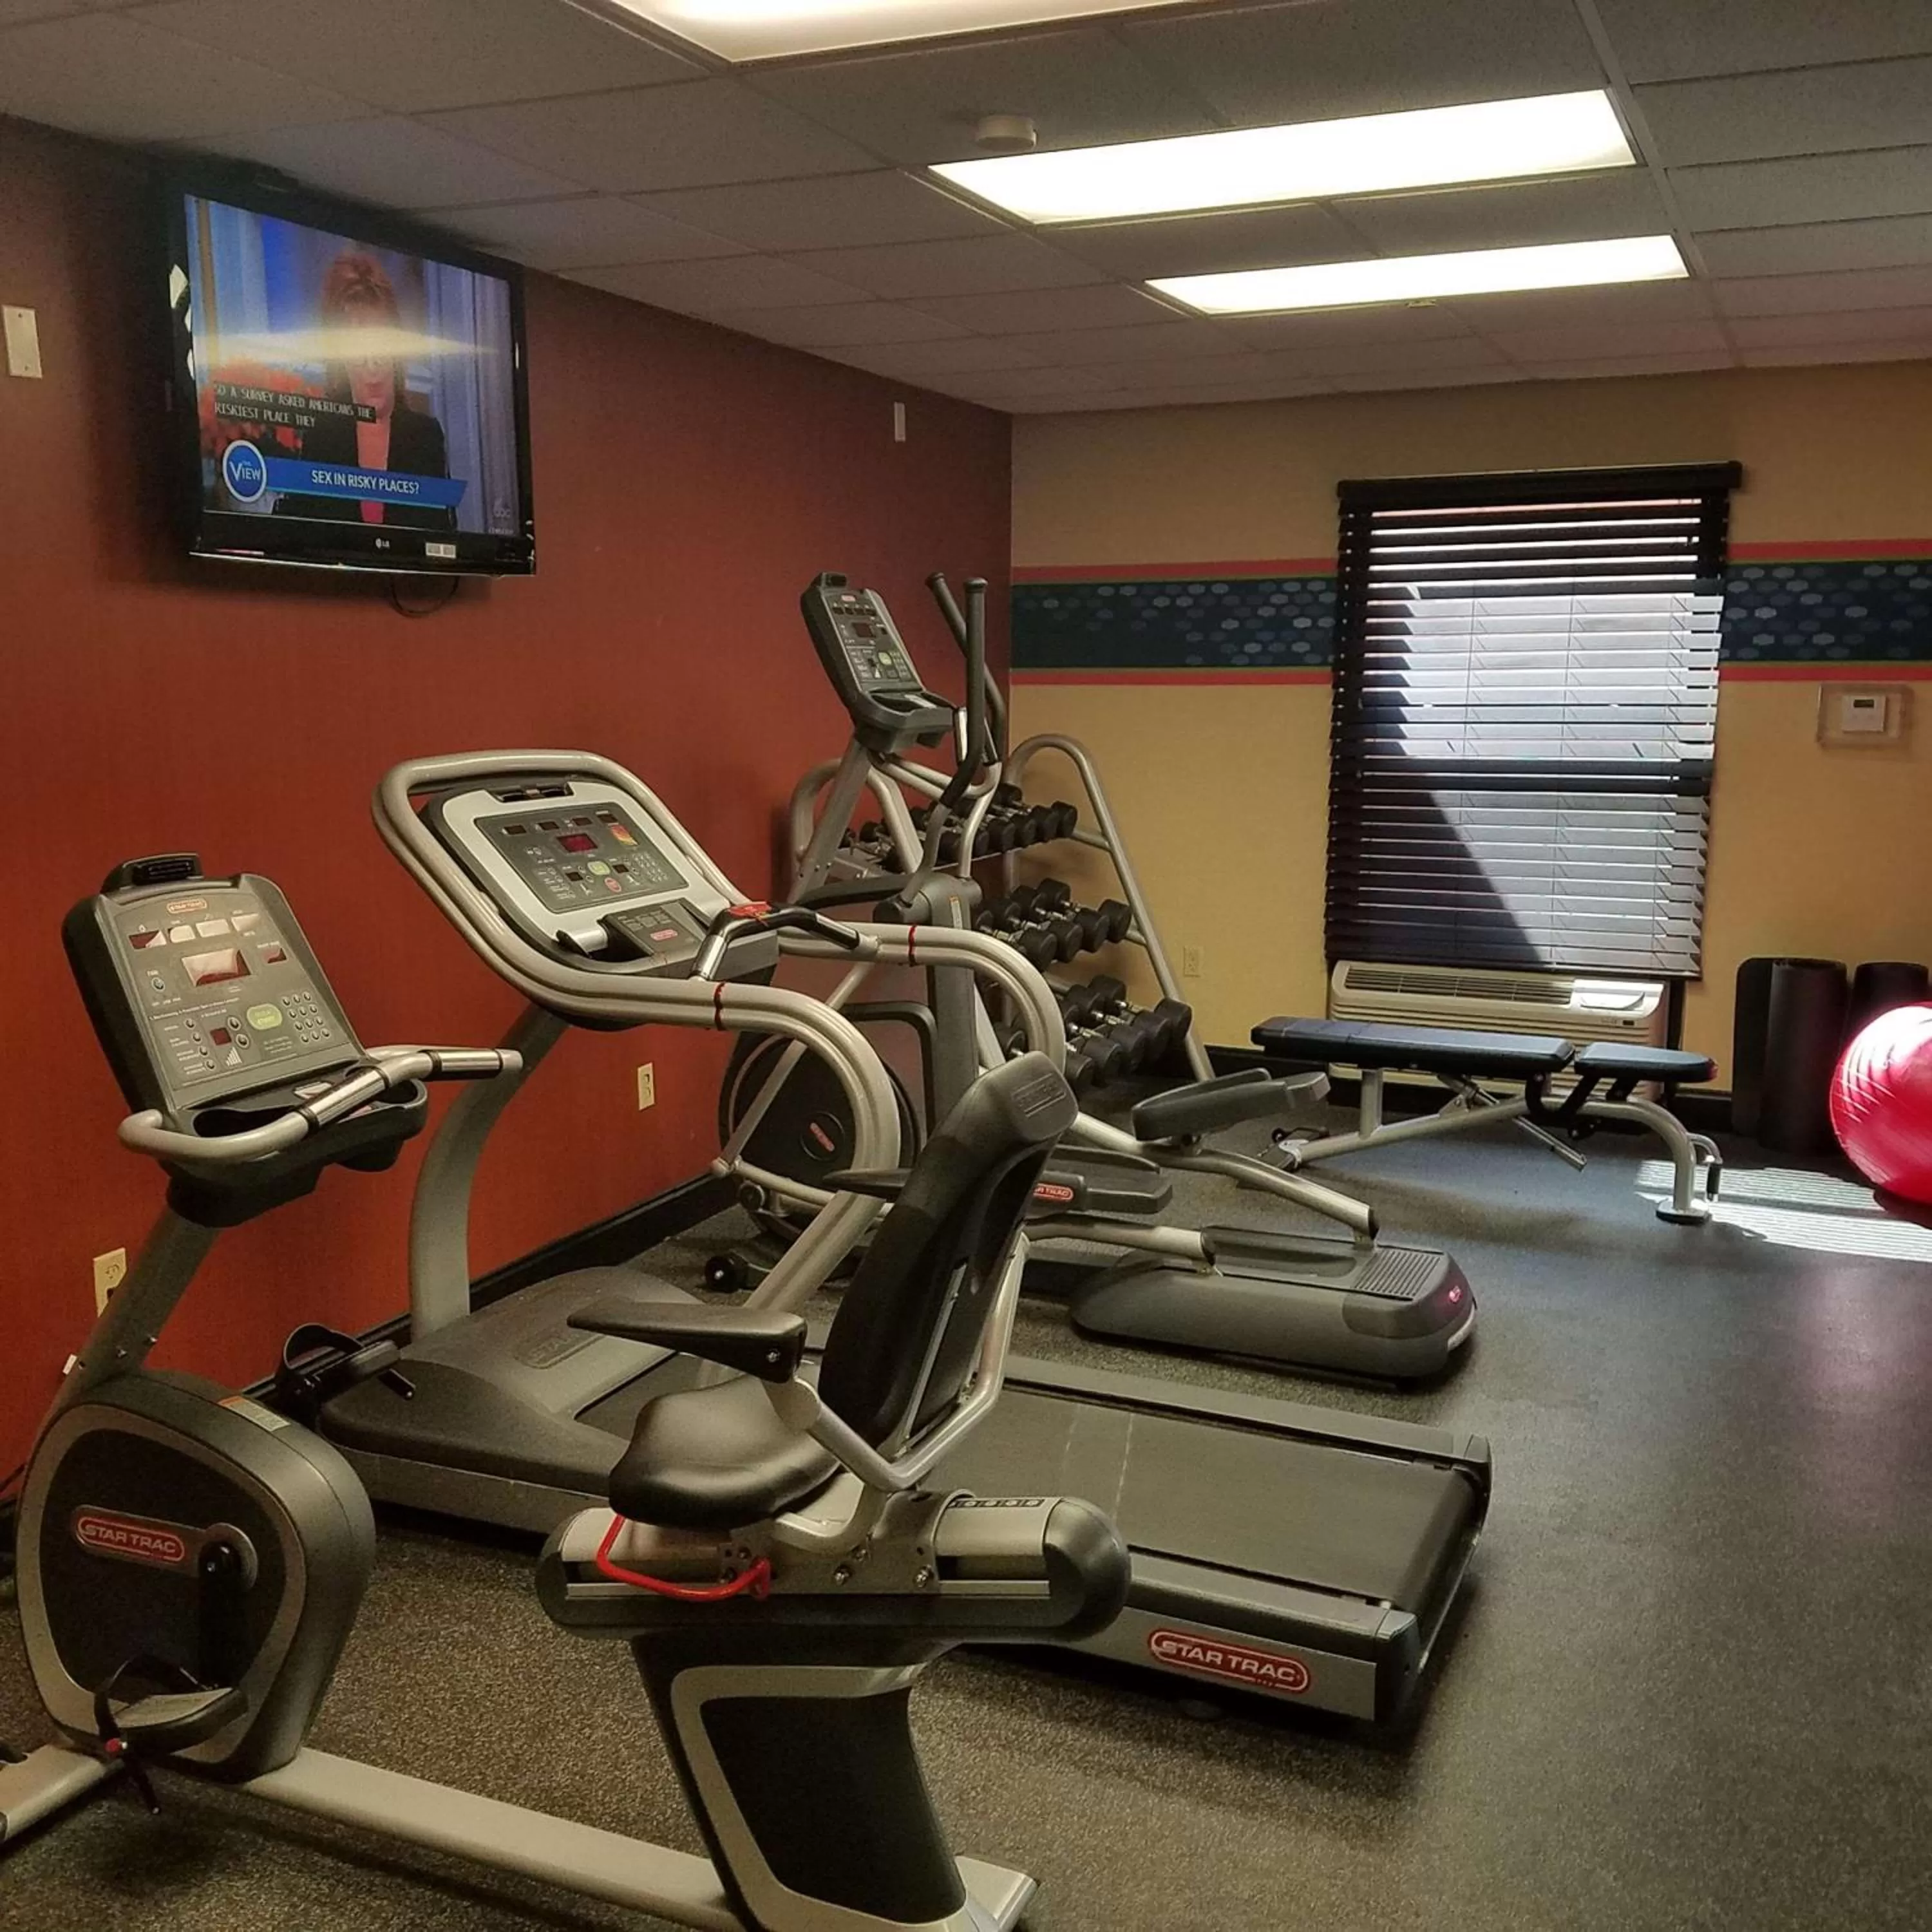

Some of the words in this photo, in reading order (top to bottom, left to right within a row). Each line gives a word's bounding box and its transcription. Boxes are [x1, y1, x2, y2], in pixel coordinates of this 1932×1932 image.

[241, 388, 274, 402] SURVEY
[278, 393, 305, 408] ASKED
[214, 401, 258, 419] RISKIEST
[263, 408, 290, 424] PLACE
[296, 413, 315, 428] THEY
[312, 469, 332, 485] SEX
[334, 472, 345, 486] IN
[348, 474, 377, 489] RISKY
[379, 477, 419, 495] PLACES?
[84, 1524, 127, 1543] STAR
[130, 1534, 176, 1553] TRAC
[1162, 1641, 1223, 1665] STAR
[1227, 1655, 1296, 1681] TRAC
